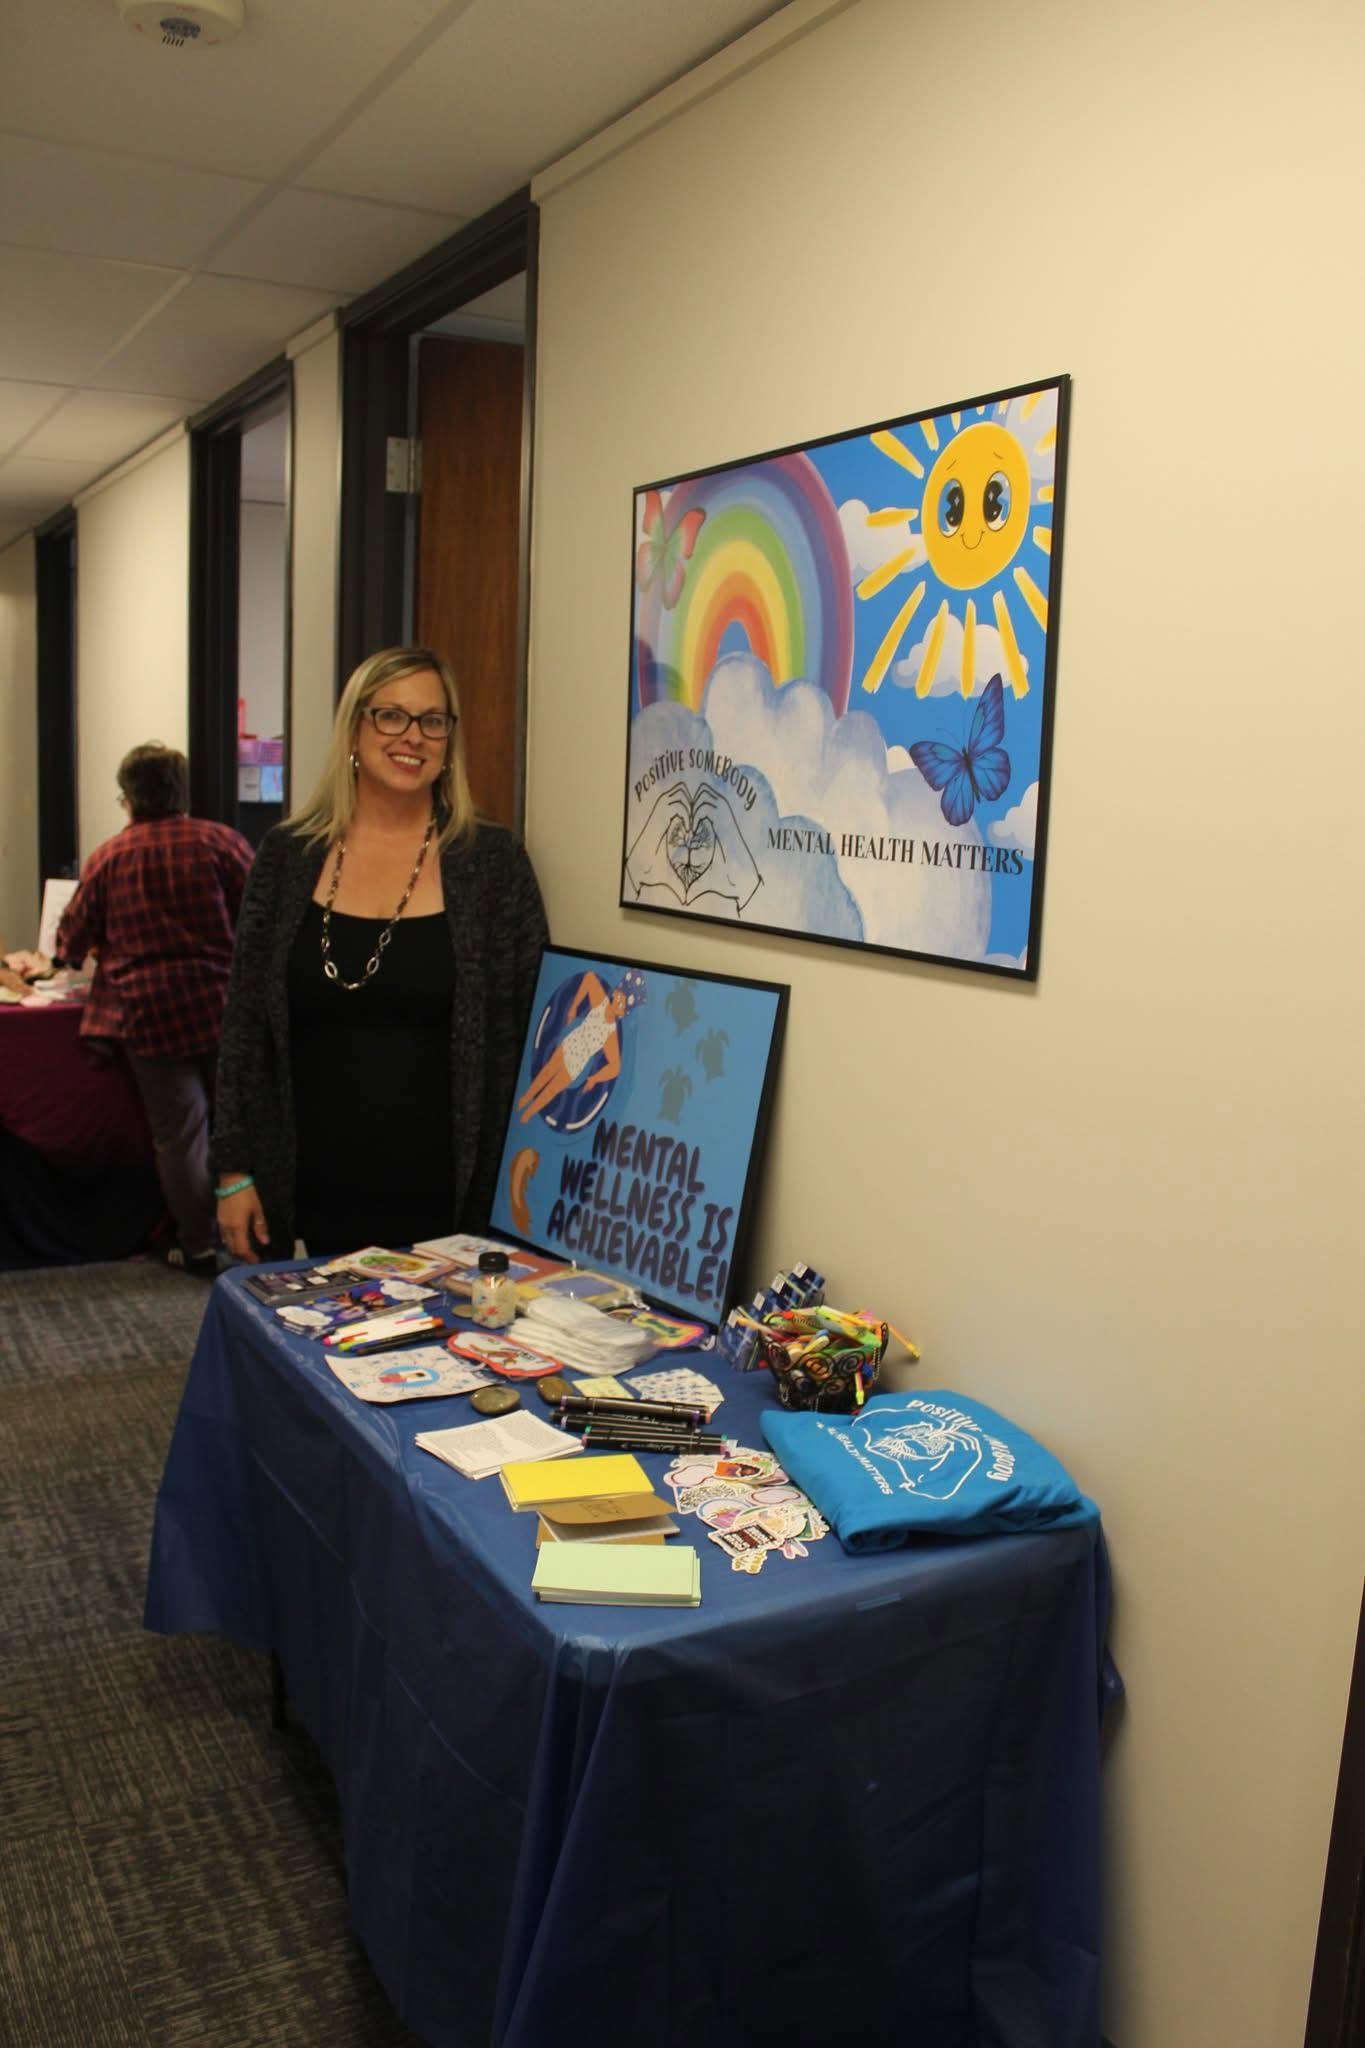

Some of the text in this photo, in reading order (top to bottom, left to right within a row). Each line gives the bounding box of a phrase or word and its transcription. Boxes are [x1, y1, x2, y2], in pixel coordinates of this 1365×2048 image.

[767, 827, 1023, 876] MENTAL HEALTH MATTERS
[591, 1117, 705, 1194] MENTAL
[560, 1154, 734, 1255] WELLNESS IS
[546, 1199, 728, 1309] ACHIEVABLE!
[906, 1399, 982, 1432] POSITIV
